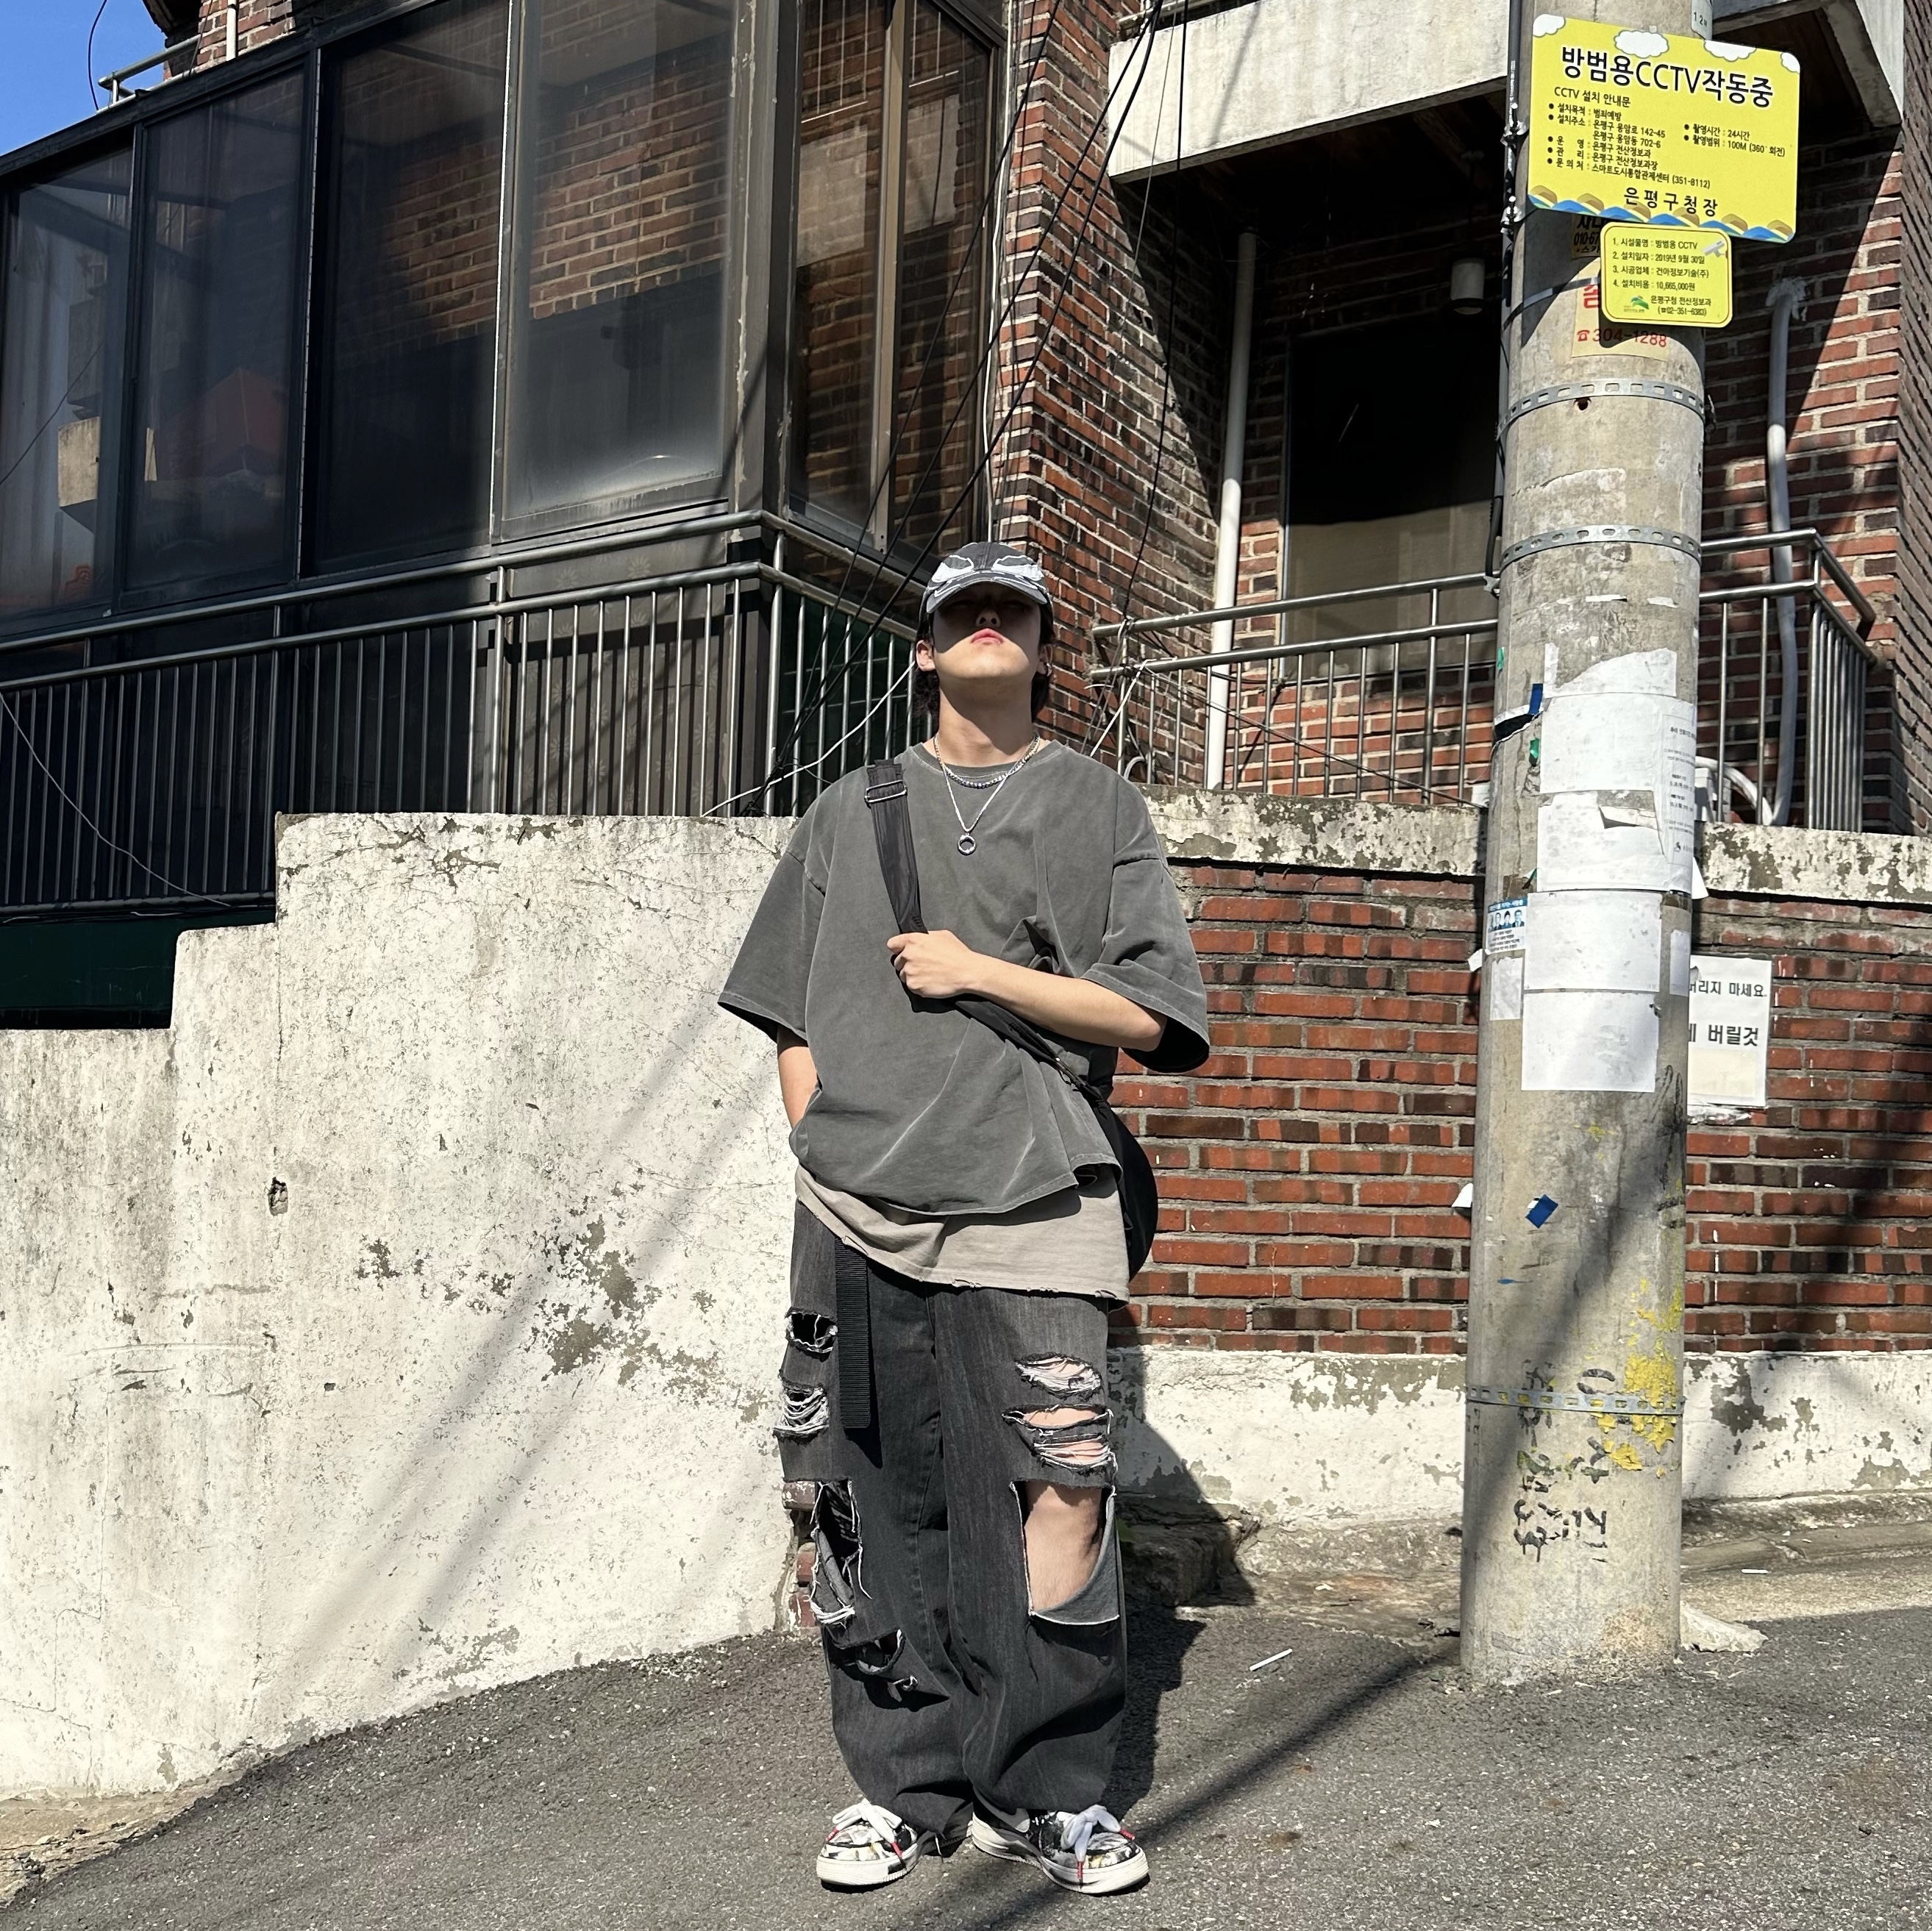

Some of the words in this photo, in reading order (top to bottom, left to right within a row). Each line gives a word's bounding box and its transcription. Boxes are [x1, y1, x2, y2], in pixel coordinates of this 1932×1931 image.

[1562, 47, 1773, 107] 방범용CCTV작동중
[1554, 87, 1580, 99] CCTV
[1582, 90, 1600, 104] 설치
[1603, 94, 1630, 107] 안내문
[1558, 103, 1586, 116] 설치목적
[1594, 108, 1622, 121] 범죄예방
[1558, 113, 1586, 126] 설치주소
[1593, 120, 1614, 131] 은평구
[1641, 126, 1666, 138] 142-45
[1593, 130, 1614, 142] 은평구
[1728, 129, 1750, 141] 24시간
[1592, 141, 1614, 153] 은평구
[1592, 152, 1614, 163] 은평구
[1678, 241, 1698, 249] CCTV
[1592, 328, 1667, 348] 304-1288
[1708, 1024, 1758, 1046] 버릴것
